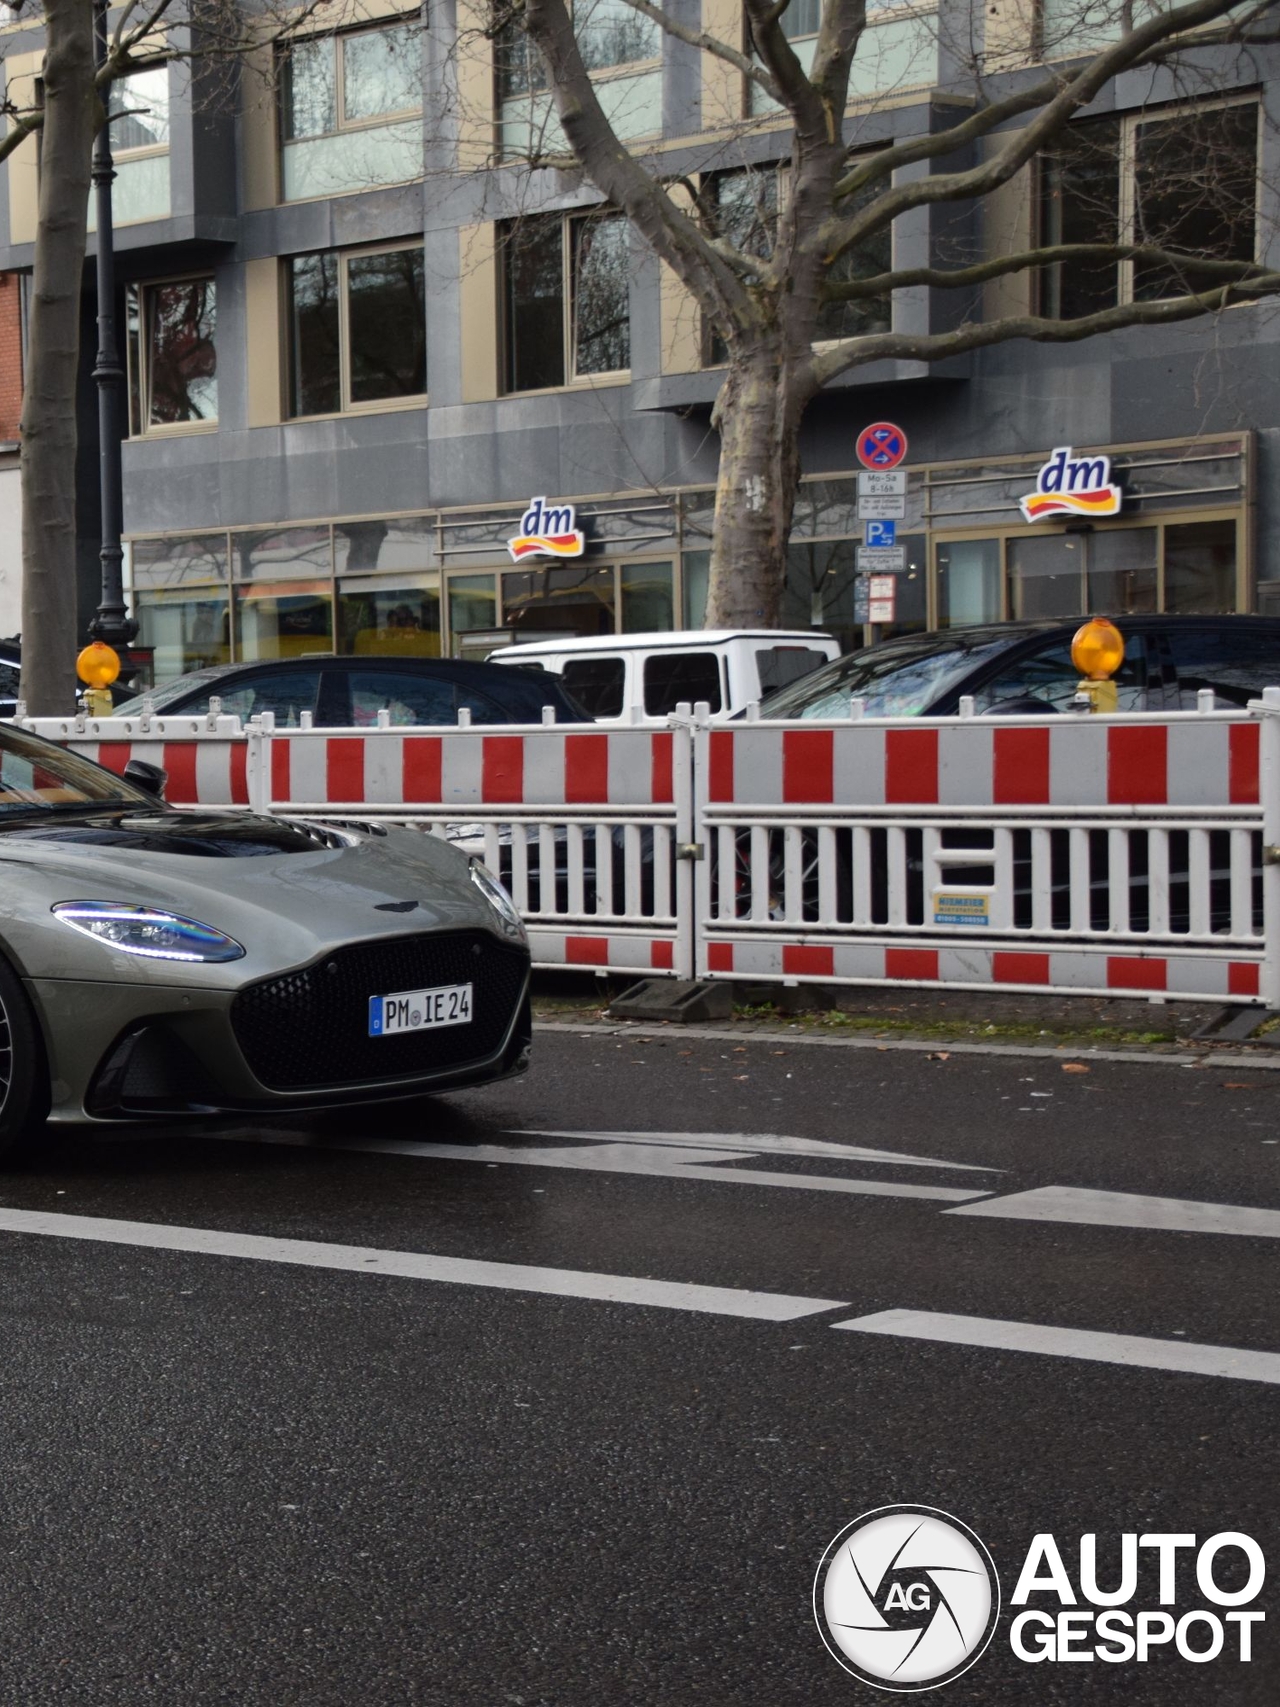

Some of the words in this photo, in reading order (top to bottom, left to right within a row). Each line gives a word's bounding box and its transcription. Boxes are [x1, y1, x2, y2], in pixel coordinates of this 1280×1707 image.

[867, 473, 897, 483] Mo-Sa
[1041, 451, 1105, 493] dm
[523, 500, 571, 536] dm
[868, 522, 884, 543] P
[386, 999, 410, 1029] PM
[424, 994, 445, 1023] IE
[448, 990, 469, 1020] 24
